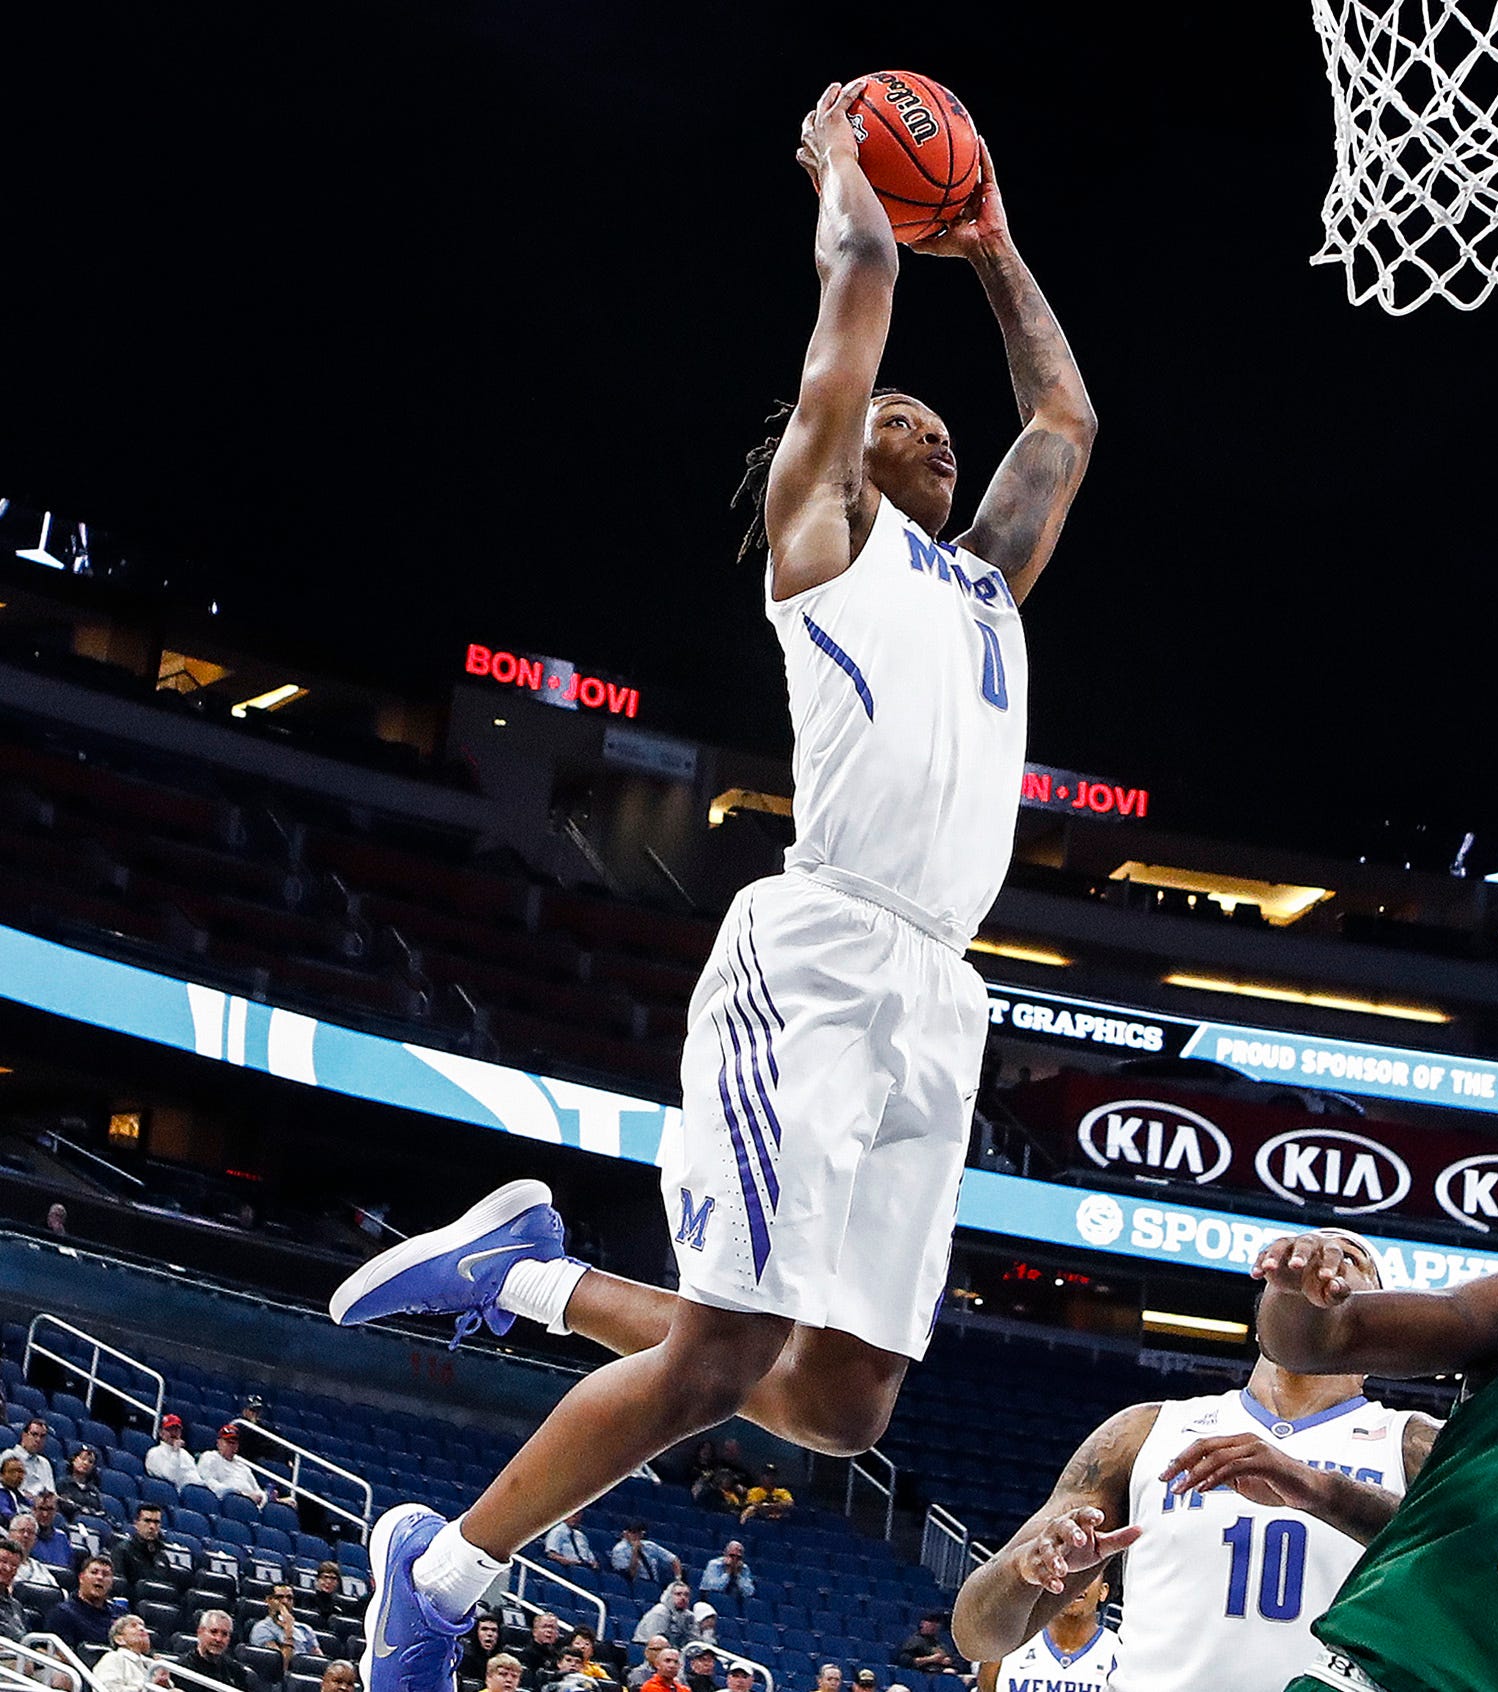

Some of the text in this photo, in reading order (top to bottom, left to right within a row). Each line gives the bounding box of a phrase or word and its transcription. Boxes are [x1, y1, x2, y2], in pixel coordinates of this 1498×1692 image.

[465, 643, 640, 718] BON JOVI
[974, 618, 1009, 712] 0
[1071, 781, 1149, 817] JOVI
[1011, 1003, 1164, 1051] GRAPHICS
[1215, 1037, 1297, 1070] PROUD
[1300, 1049, 1409, 1089] SPONSOR
[1412, 1064, 1445, 1090] OF
[1449, 1069, 1496, 1098] THE
[1106, 1113, 1204, 1174] KIA
[1282, 1143, 1384, 1201] KIA
[675, 1187, 716, 1252] M
[1221, 1515, 1310, 1623] 10
